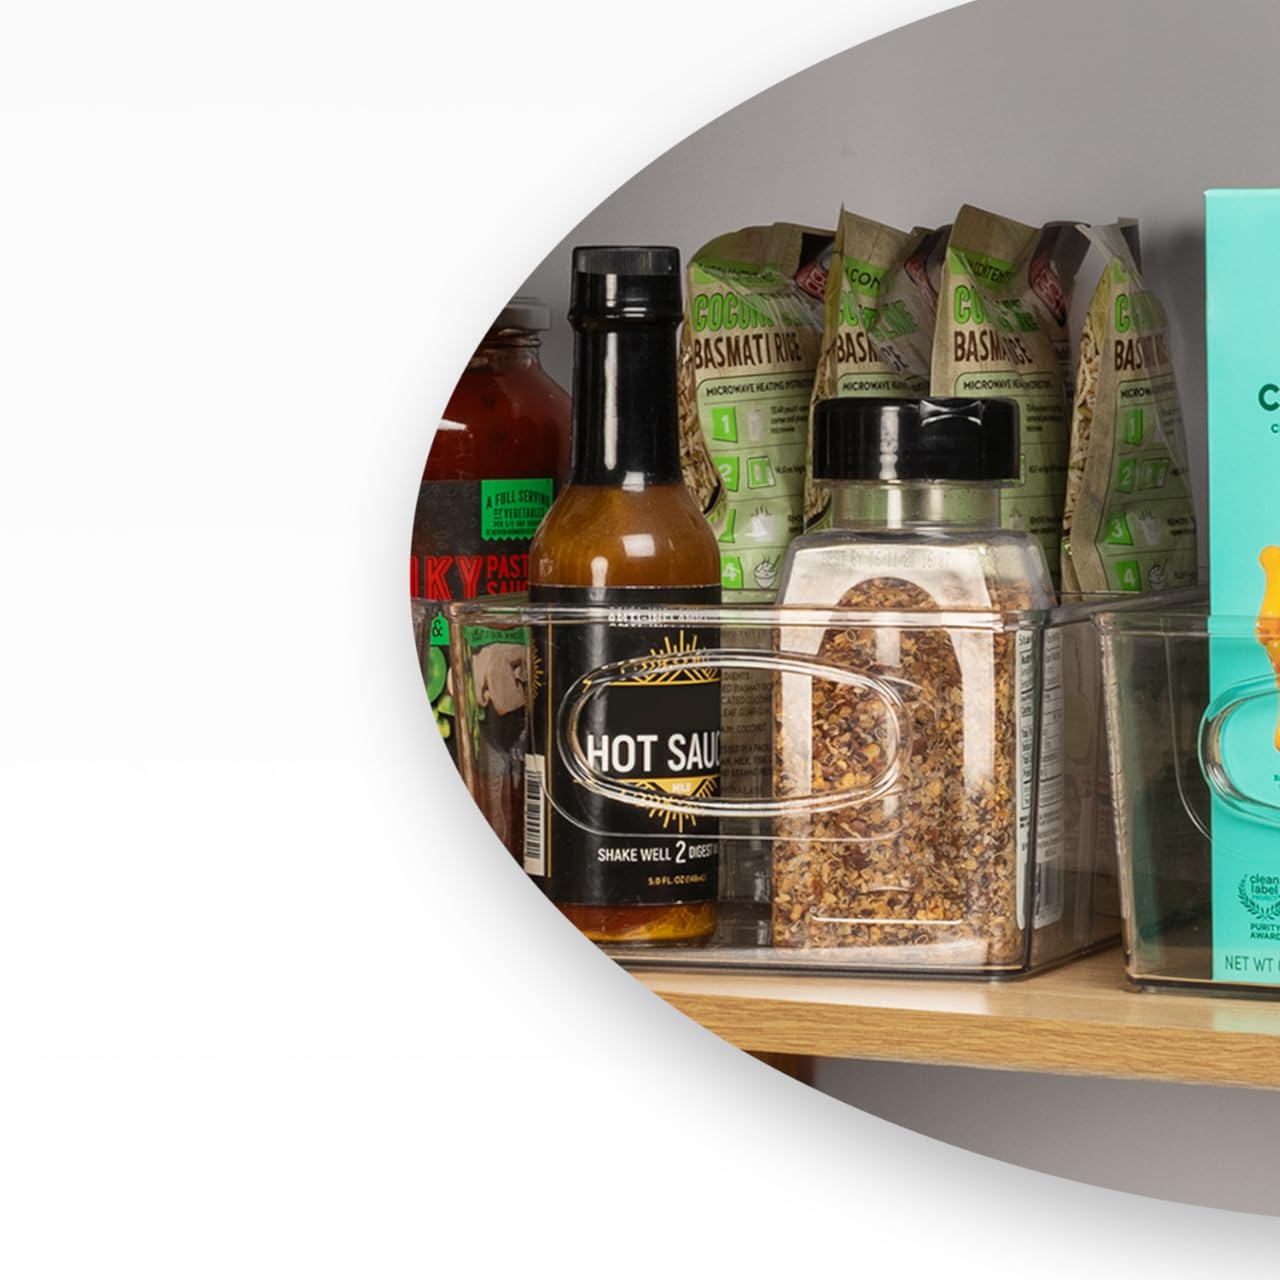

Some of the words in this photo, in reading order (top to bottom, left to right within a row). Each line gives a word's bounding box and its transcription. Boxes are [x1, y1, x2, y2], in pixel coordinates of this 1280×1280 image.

[693, 332, 772, 370] BASMATI
[774, 331, 803, 363] RICE
[705, 383, 755, 397] MICROWAVE
[963, 378, 1014, 392] MICROWAVE
[495, 490, 516, 505] FULL
[1110, 521, 1123, 538] 3
[486, 554, 529, 579] PAST
[1123, 566, 1136, 587] 4
[431, 619, 443, 637] &
[587, 733, 659, 773] HOT
[597, 847, 639, 863] SHAKE
[640, 847, 673, 862] WELL
[674, 839, 687, 864] 2
[1249, 872, 1280, 885] clean
[1250, 883, 1279, 896] label
[1224, 954, 1250, 972] NET
[1251, 957, 1274, 974] WT
